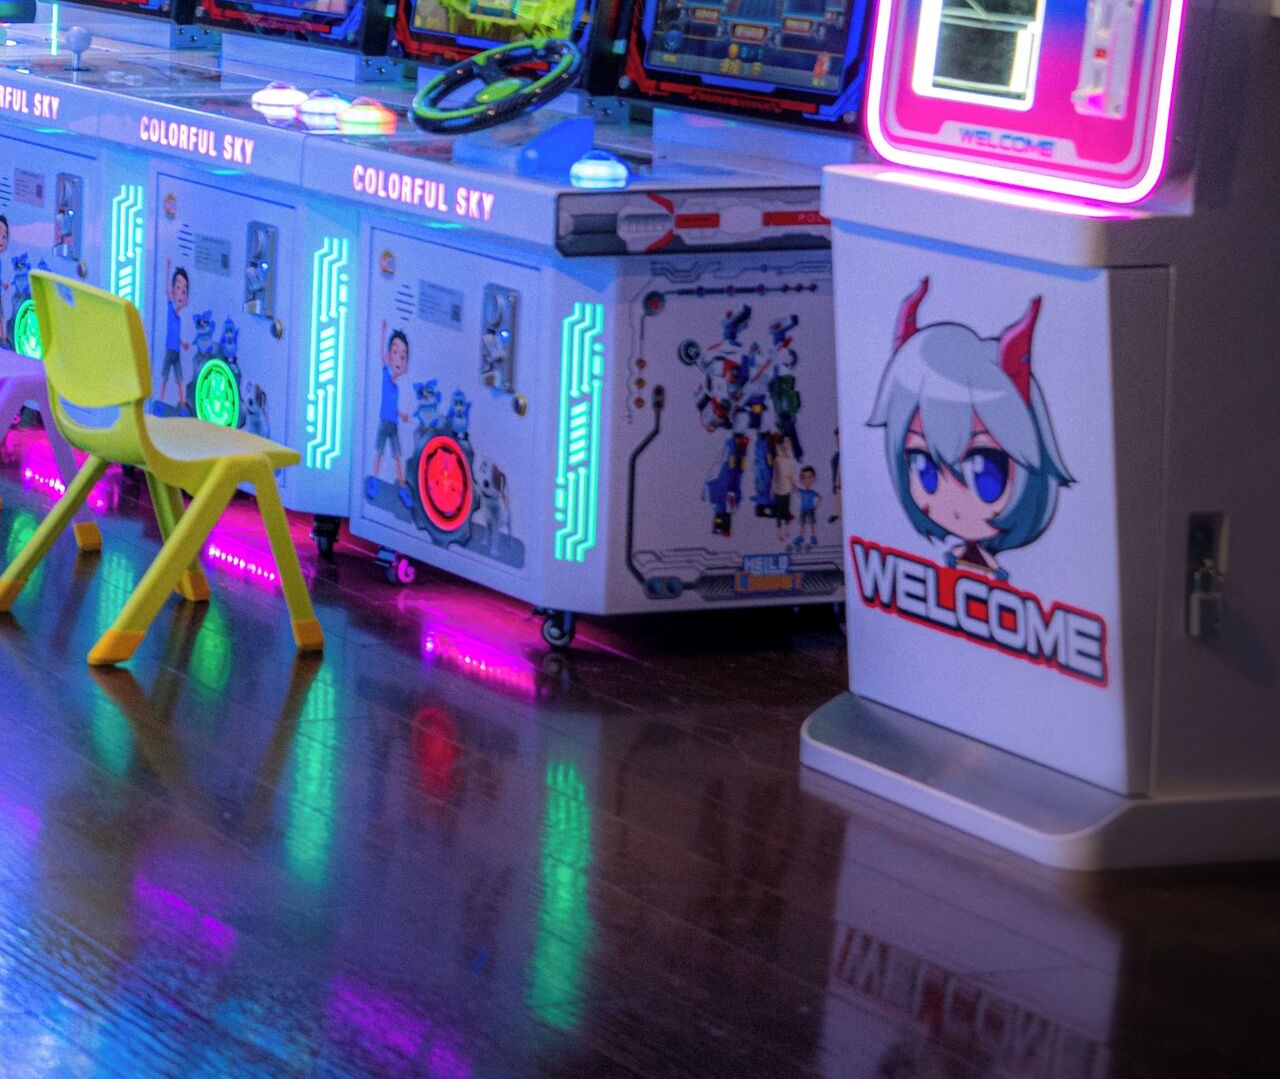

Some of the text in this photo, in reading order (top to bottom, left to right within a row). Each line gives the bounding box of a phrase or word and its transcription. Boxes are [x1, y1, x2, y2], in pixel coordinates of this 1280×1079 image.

[33, 92, 61, 120] SKY
[140, 115, 255, 165] COLORFUL SKY
[960, 128, 1054, 158] WELCOME
[352, 164, 495, 221] COLORFUL SKY
[852, 541, 1105, 680] WELCOME
